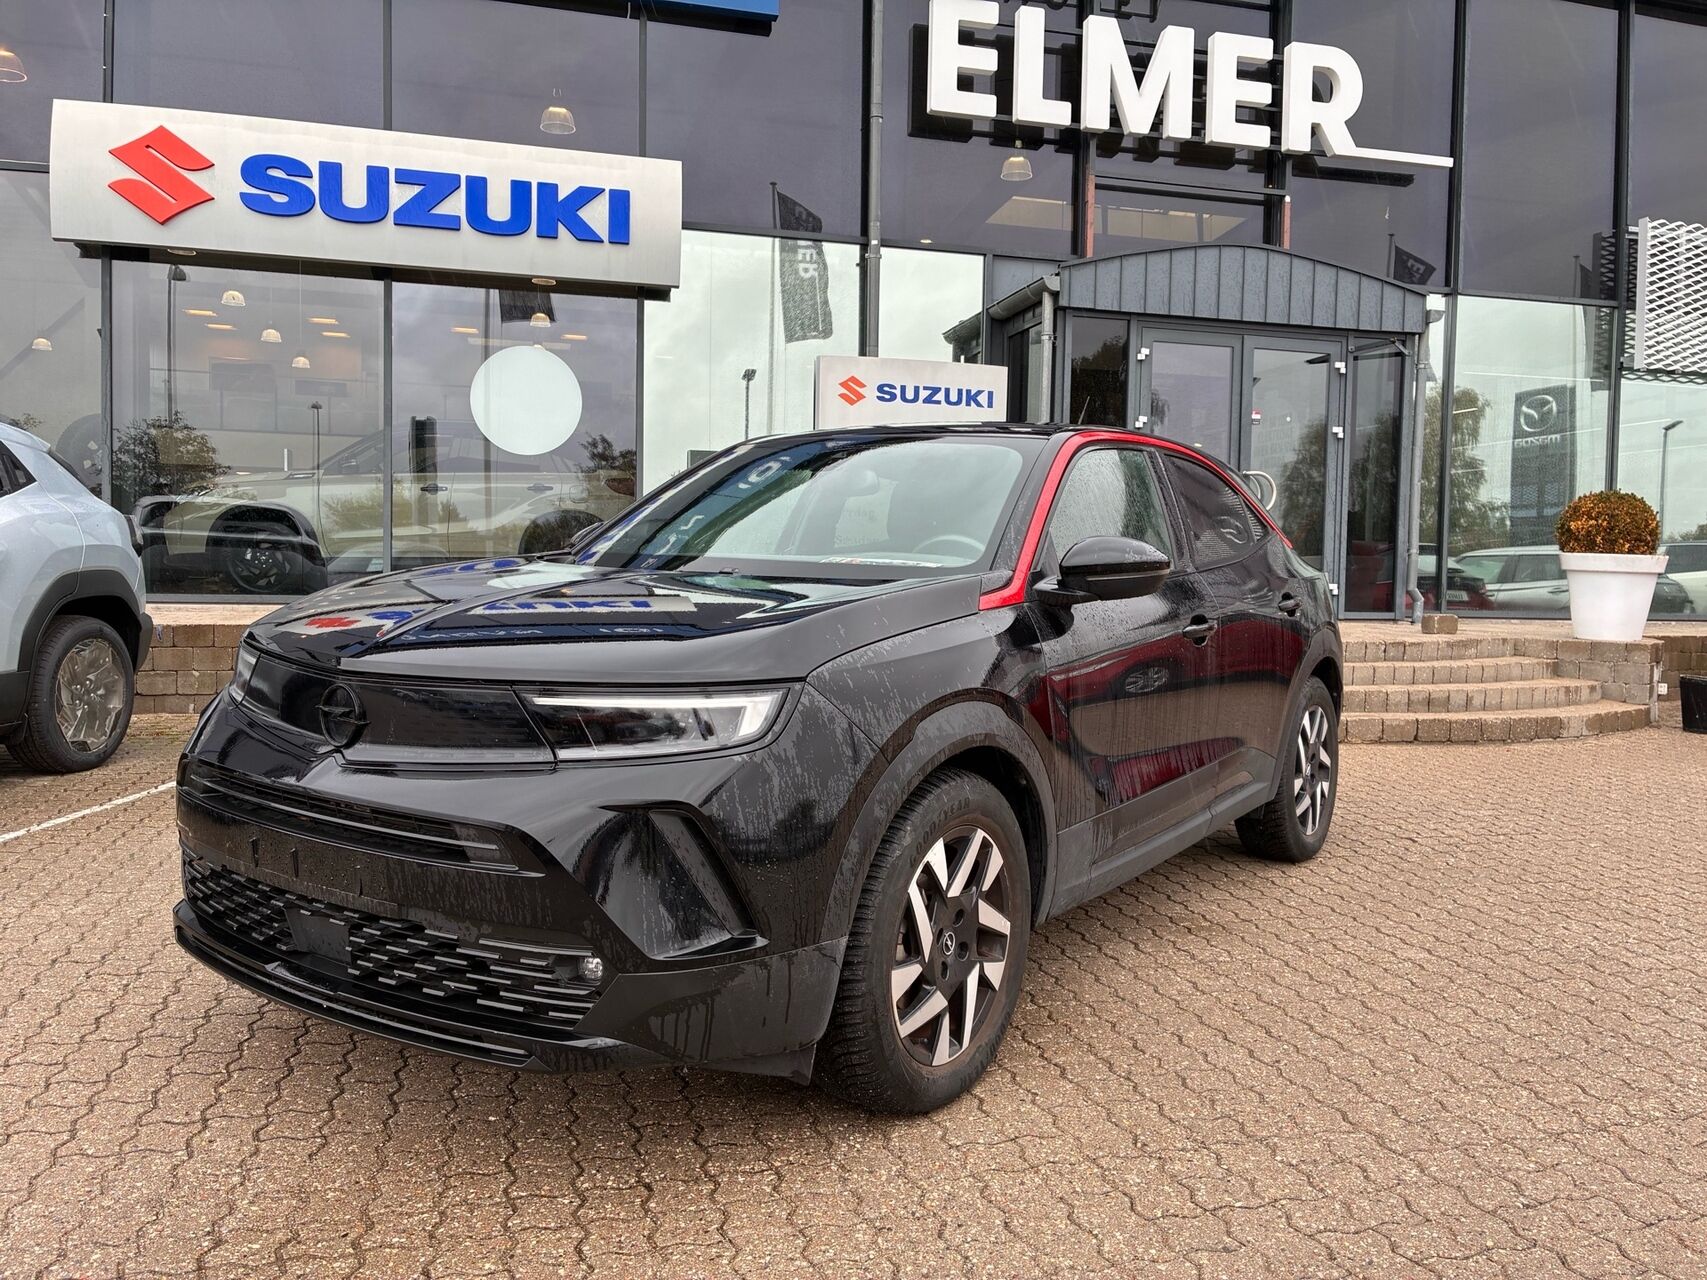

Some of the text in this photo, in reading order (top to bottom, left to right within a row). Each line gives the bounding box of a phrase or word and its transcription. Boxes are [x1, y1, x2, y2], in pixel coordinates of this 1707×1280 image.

[926, 0, 1364, 157] ELMER
[239, 153, 631, 245] SUZUKI
[876, 383, 994, 409] SUZUKI
